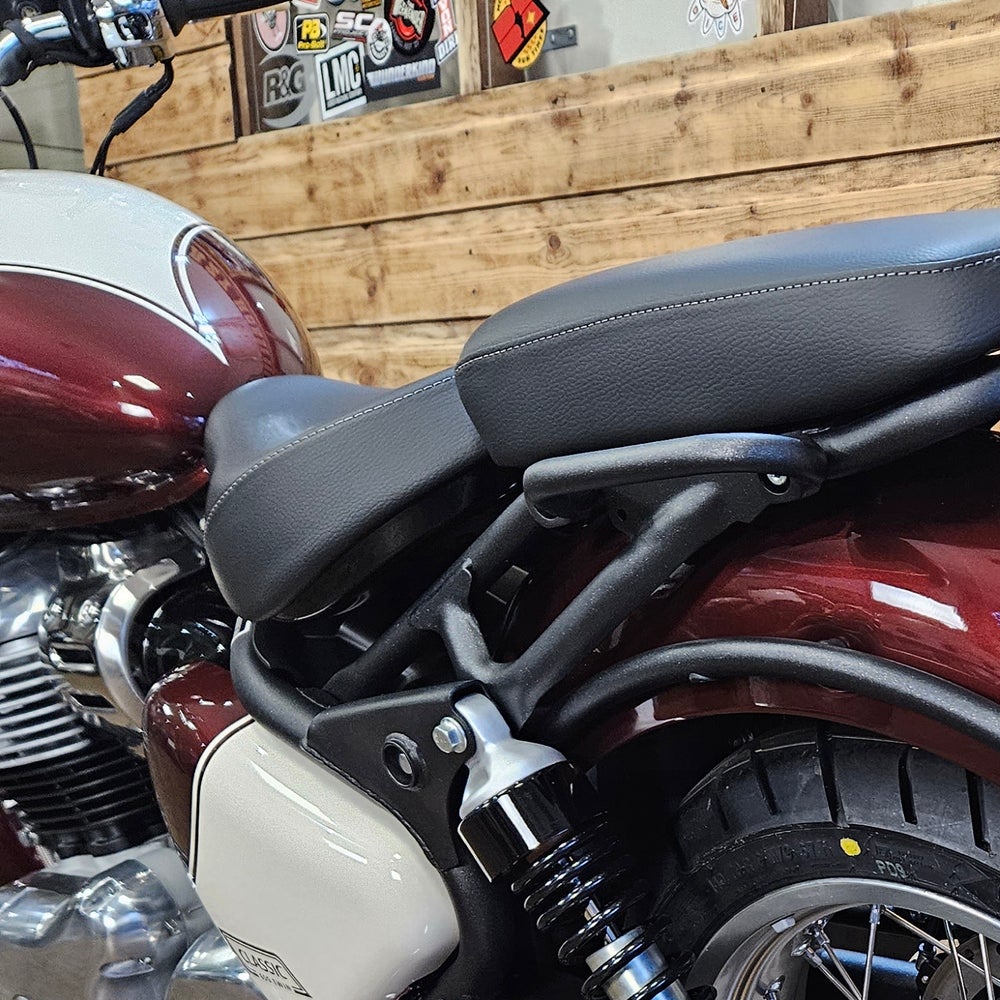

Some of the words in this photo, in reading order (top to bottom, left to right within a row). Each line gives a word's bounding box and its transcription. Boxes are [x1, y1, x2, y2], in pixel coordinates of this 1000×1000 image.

[301, 18, 321, 40] PB
[265, 63, 304, 103] R&G
[322, 50, 362, 101] LMC
[238, 948, 288, 980] CLASSIC
